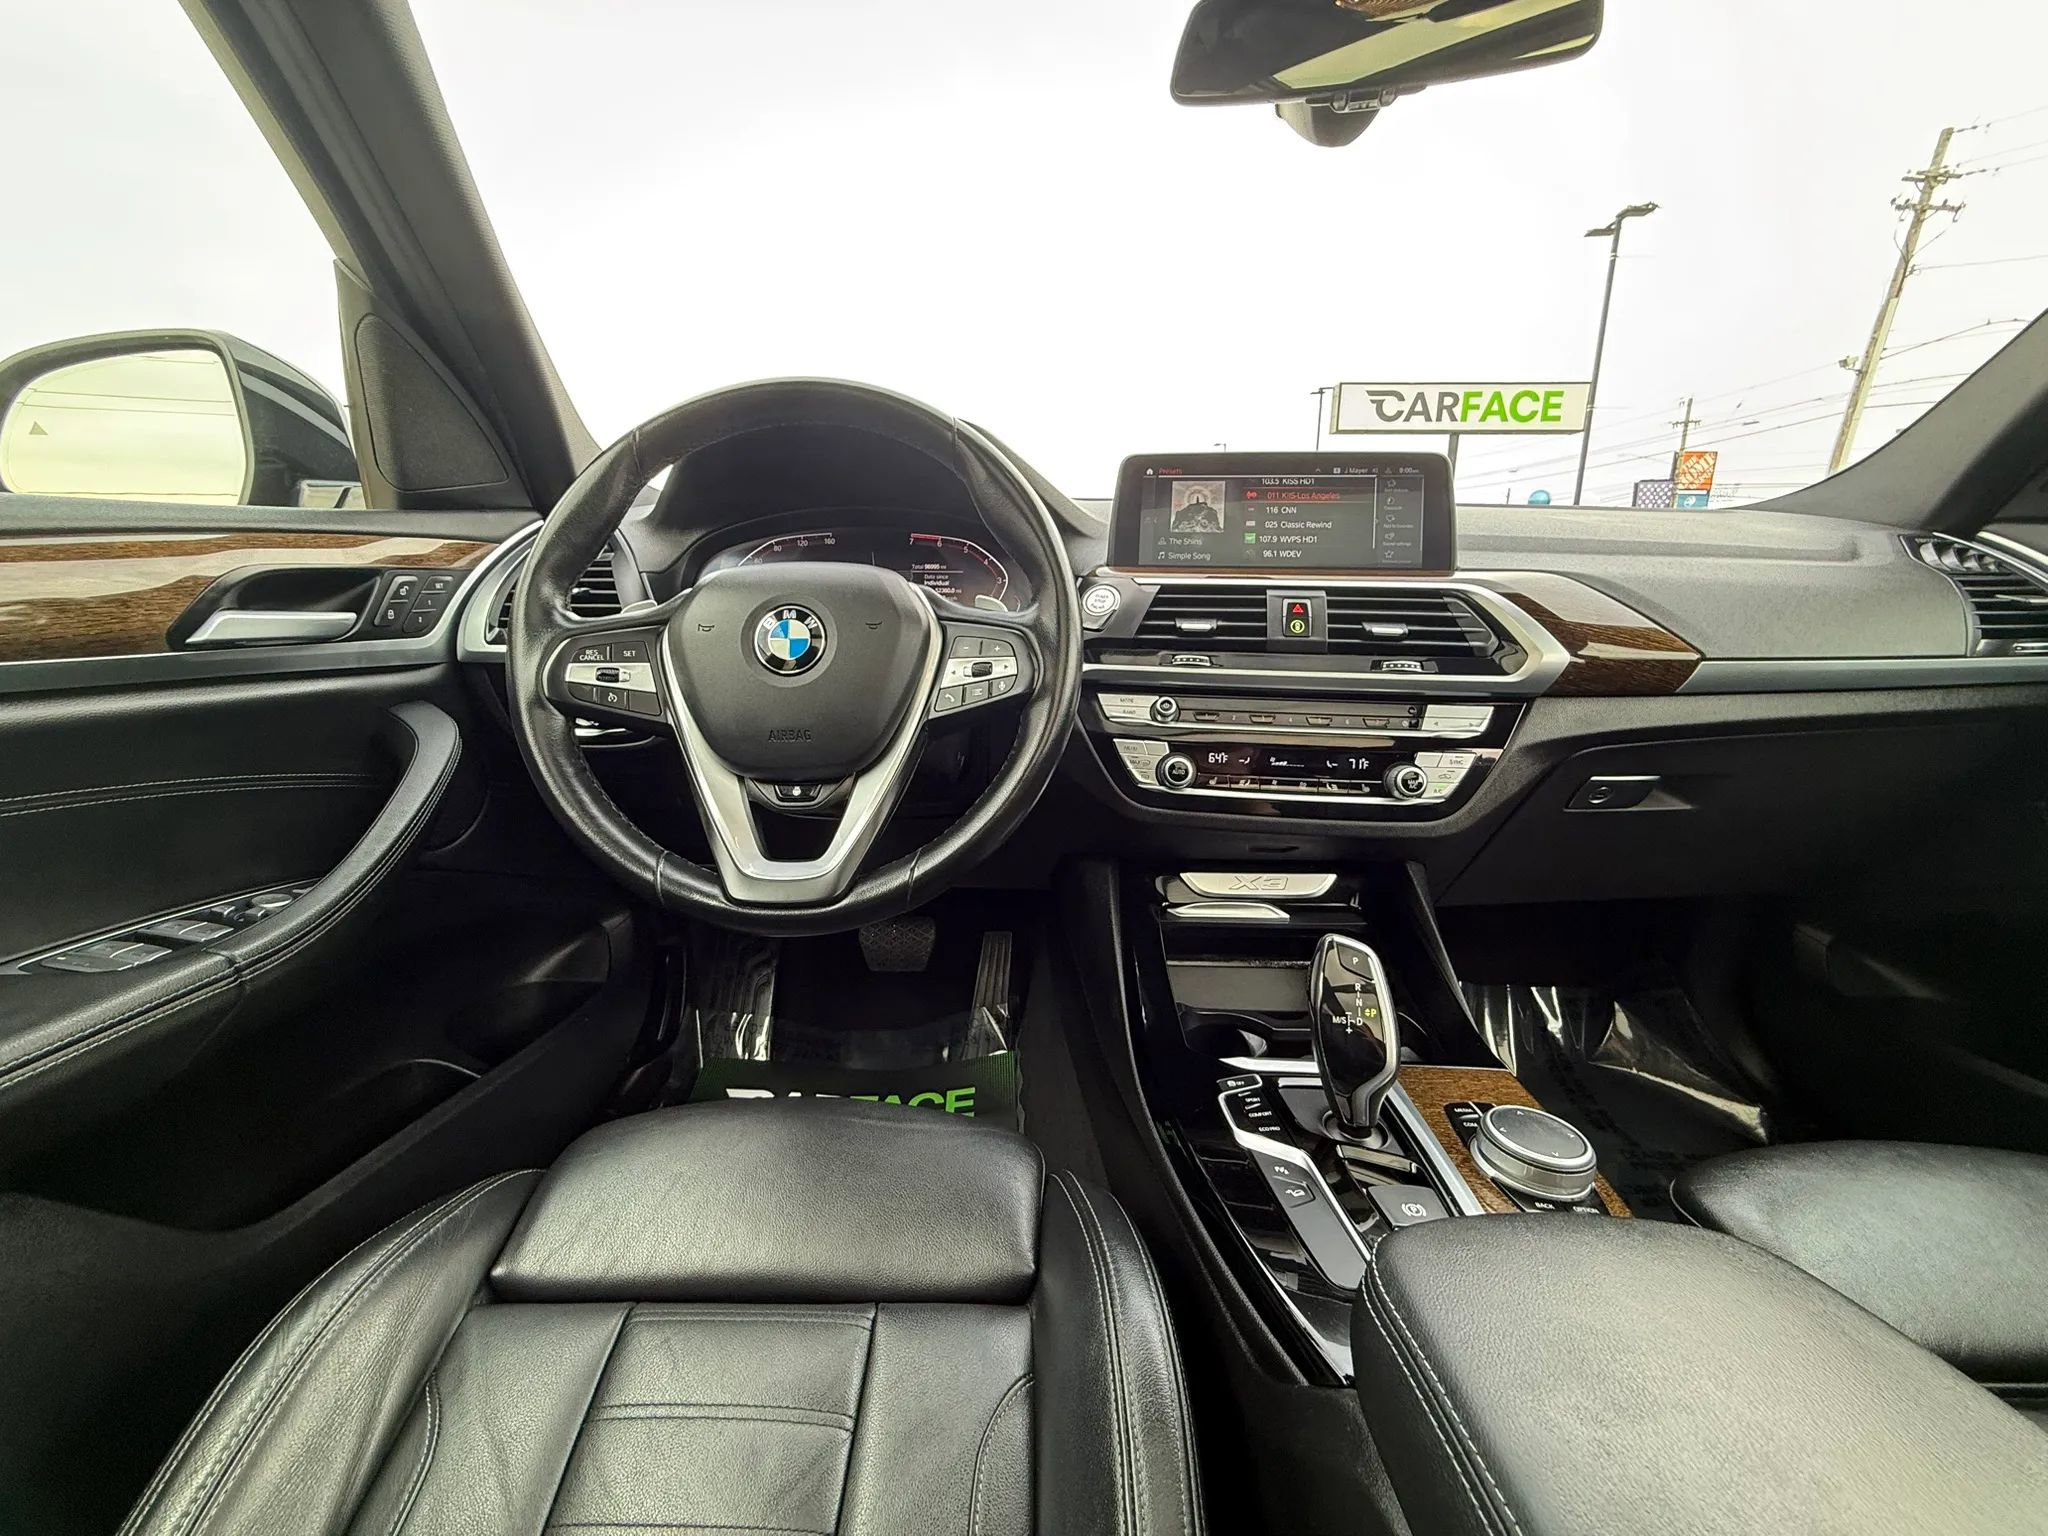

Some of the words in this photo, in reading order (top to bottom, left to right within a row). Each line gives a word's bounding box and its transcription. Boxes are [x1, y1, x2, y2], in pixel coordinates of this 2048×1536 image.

[1366, 390, 1565, 423] CARFACE
[1311, 492, 1340, 501] Angeles
[1169, 537, 1182, 545] The
[1259, 535, 1278, 543] 107.9
[1280, 535, 1301, 543] WVPS
[1302, 535, 1318, 543] HD1
[1168, 552, 1191, 560] Simple
[1192, 552, 1211, 561] Song
[1263, 550, 1277, 558] 96.1
[763, 609, 818, 630] BMW
[768, 729, 812, 742] AIRBAG
[1229, 876, 1288, 890] X3
[1353, 957, 1359, 965] P
[1355, 983, 1361, 991] R
[1371, 1009, 1377, 1017] P
